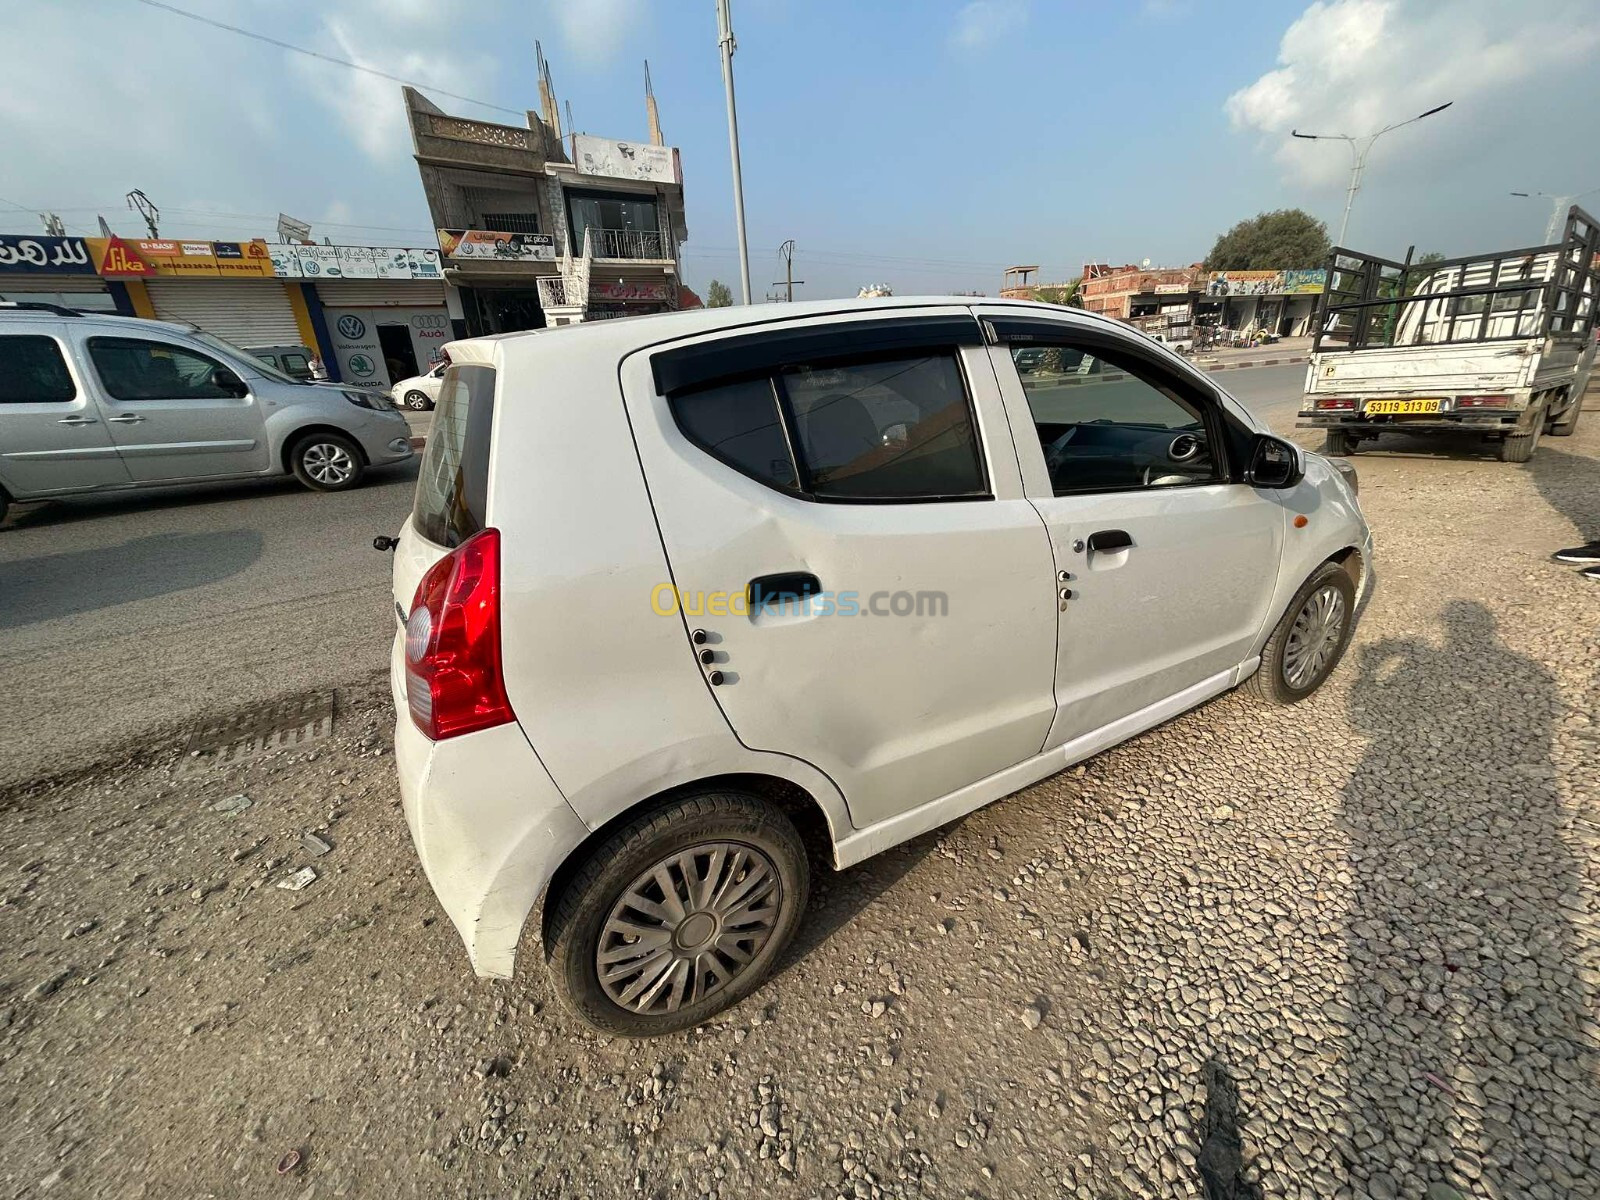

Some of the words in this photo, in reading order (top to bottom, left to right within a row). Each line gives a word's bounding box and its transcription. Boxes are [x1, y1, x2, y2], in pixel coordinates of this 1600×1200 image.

[152, 242, 175, 250] BASF
[105, 246, 145, 271] Sika
[299, 246, 343, 262] السيارات
[344, 247, 366, 263] غيار
[366, 248, 390, 263] قطع
[418, 329, 445, 338] Audi
[1370, 402, 1399, 412] 53119
[1403, 401, 1422, 412] 313
[1424, 401, 1438, 411] 09
